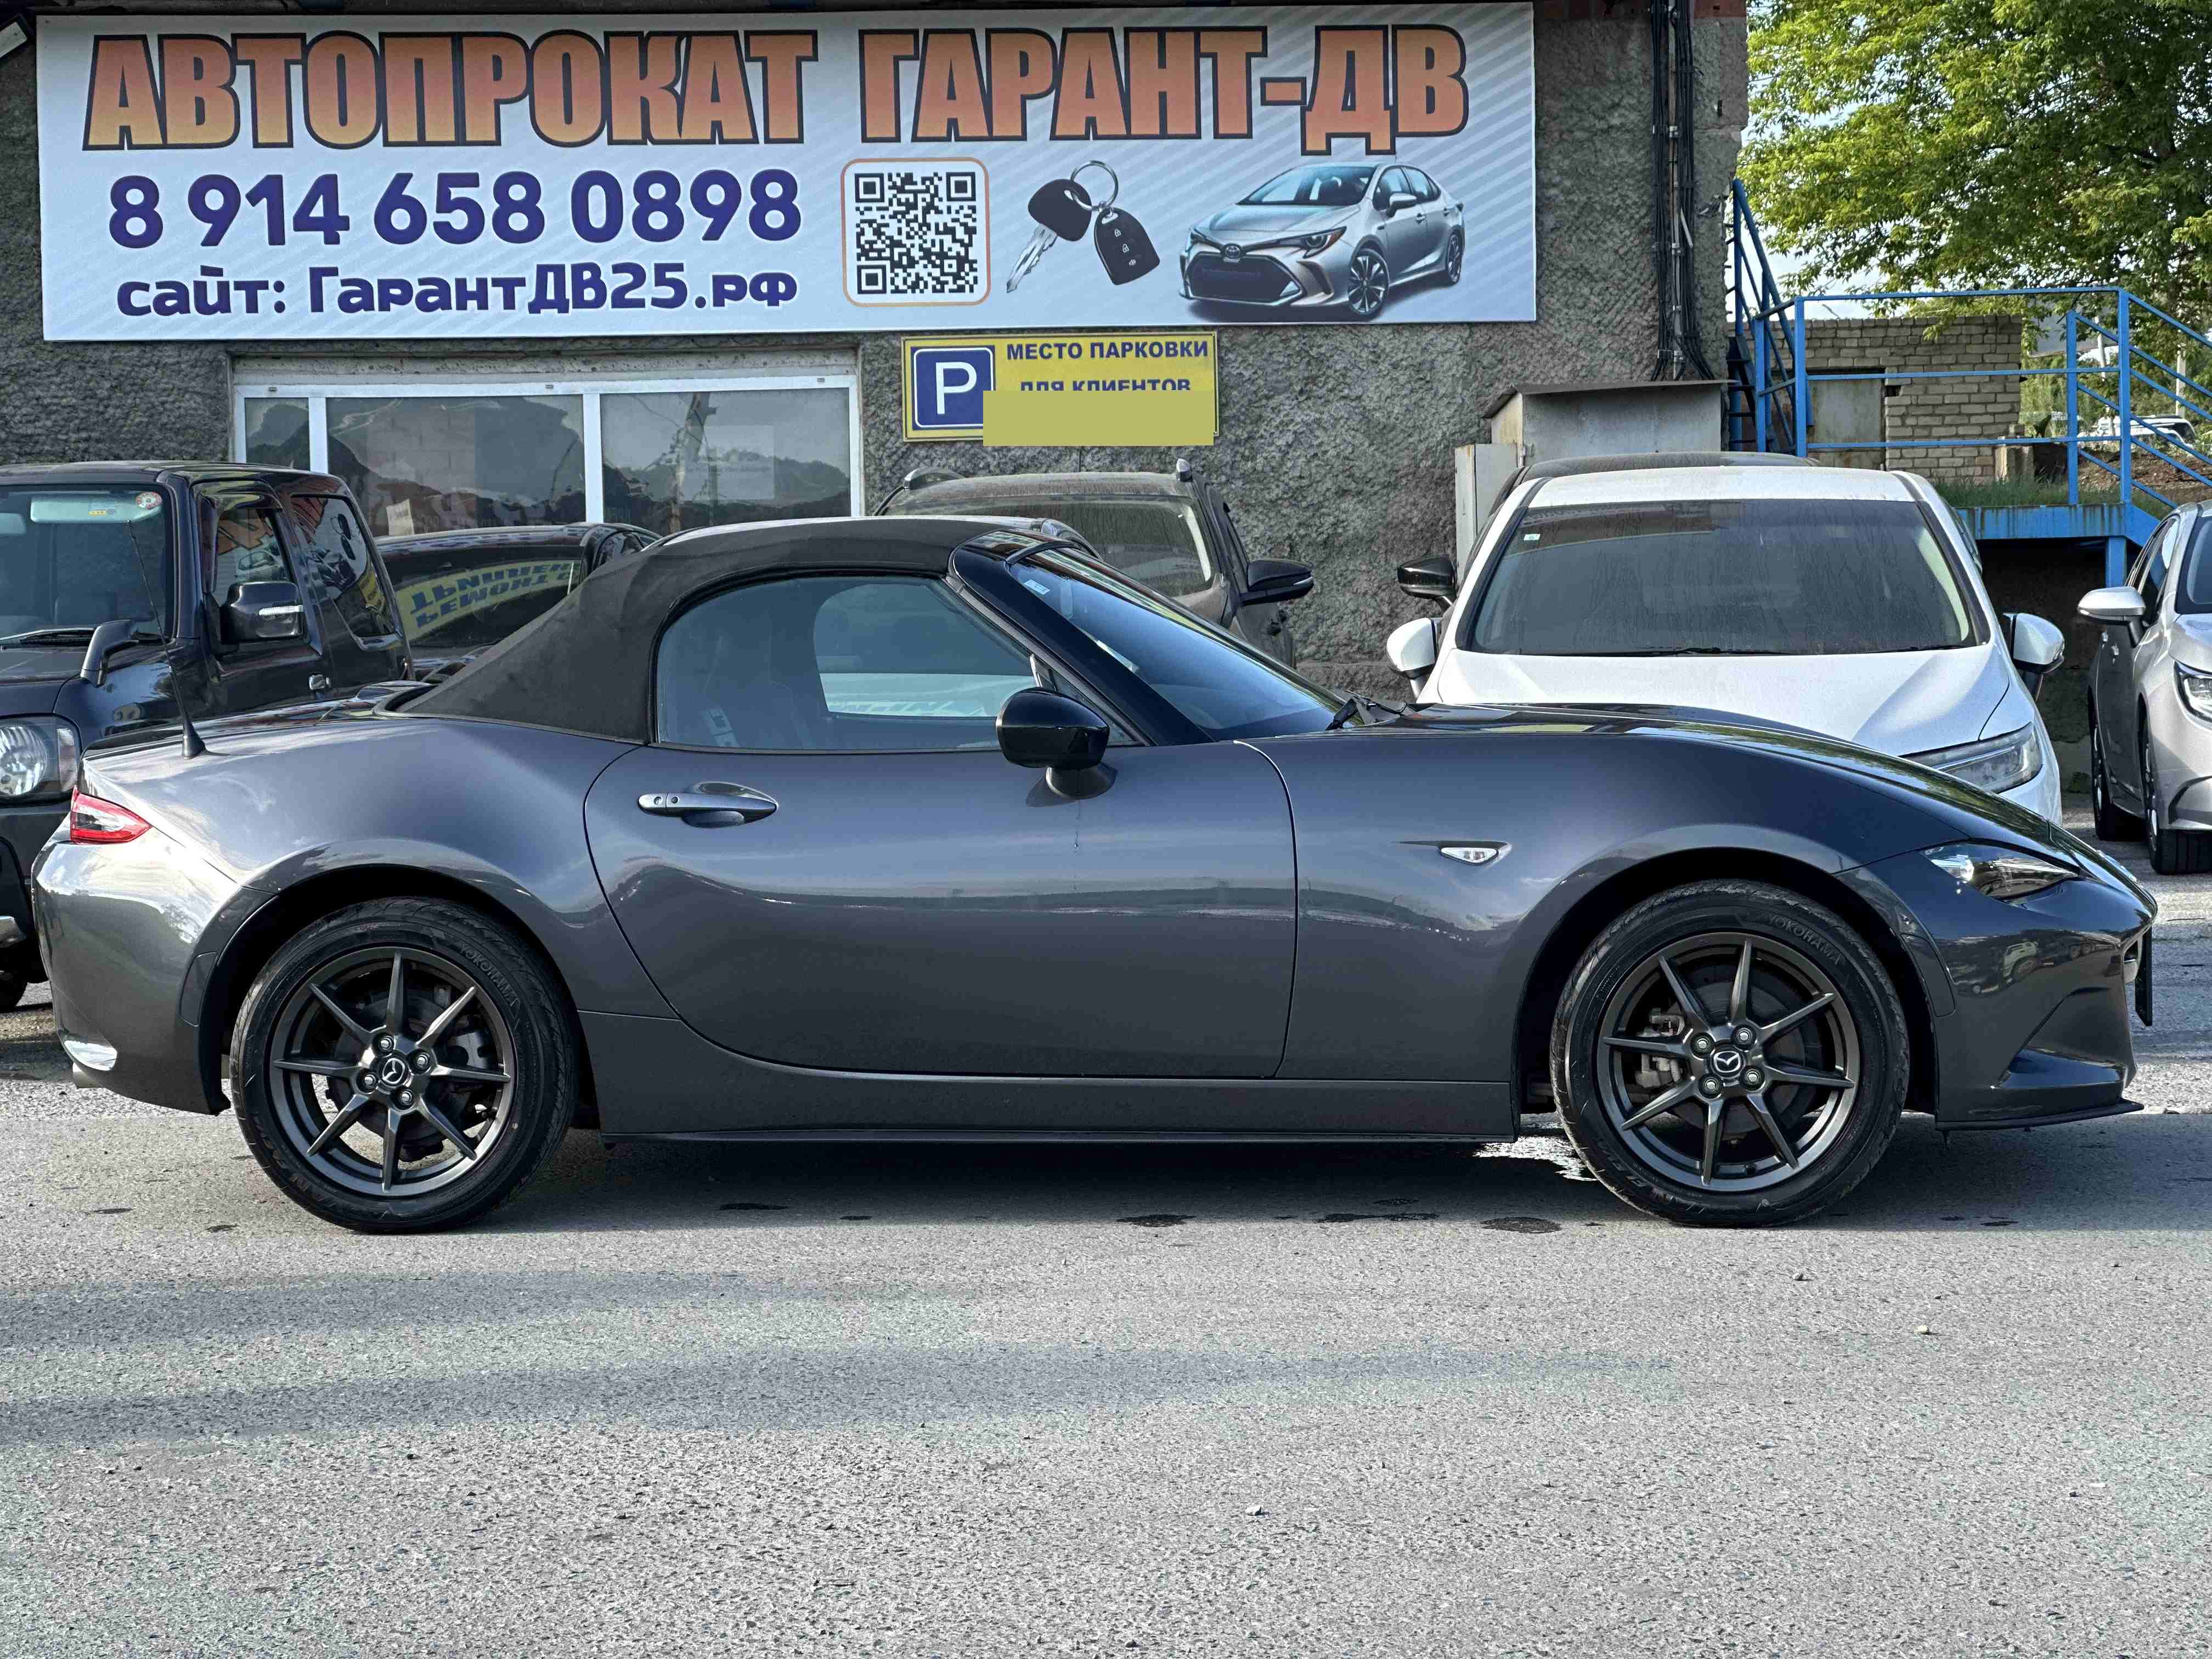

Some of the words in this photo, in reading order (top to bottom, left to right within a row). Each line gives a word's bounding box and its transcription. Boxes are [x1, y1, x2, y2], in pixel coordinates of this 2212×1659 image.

[83, 29, 818, 151] АВТОПРОКАТ
[859, 24, 1469, 156] ГАРАНТ-ДВ
[110, 176, 163, 249] 8
[188, 174, 350, 247] 914
[374, 172, 545, 245] 658
[571, 169, 801, 243] 0898
[117, 264, 286, 317] сайт:
[309, 261, 798, 315] ГарантДВ25.рф
[1006, 342, 1082, 360] МЕСТО
[1090, 341, 1208, 359] ПАРКОВКИ
[1768, 912, 1844, 966] YOKOHAMA
